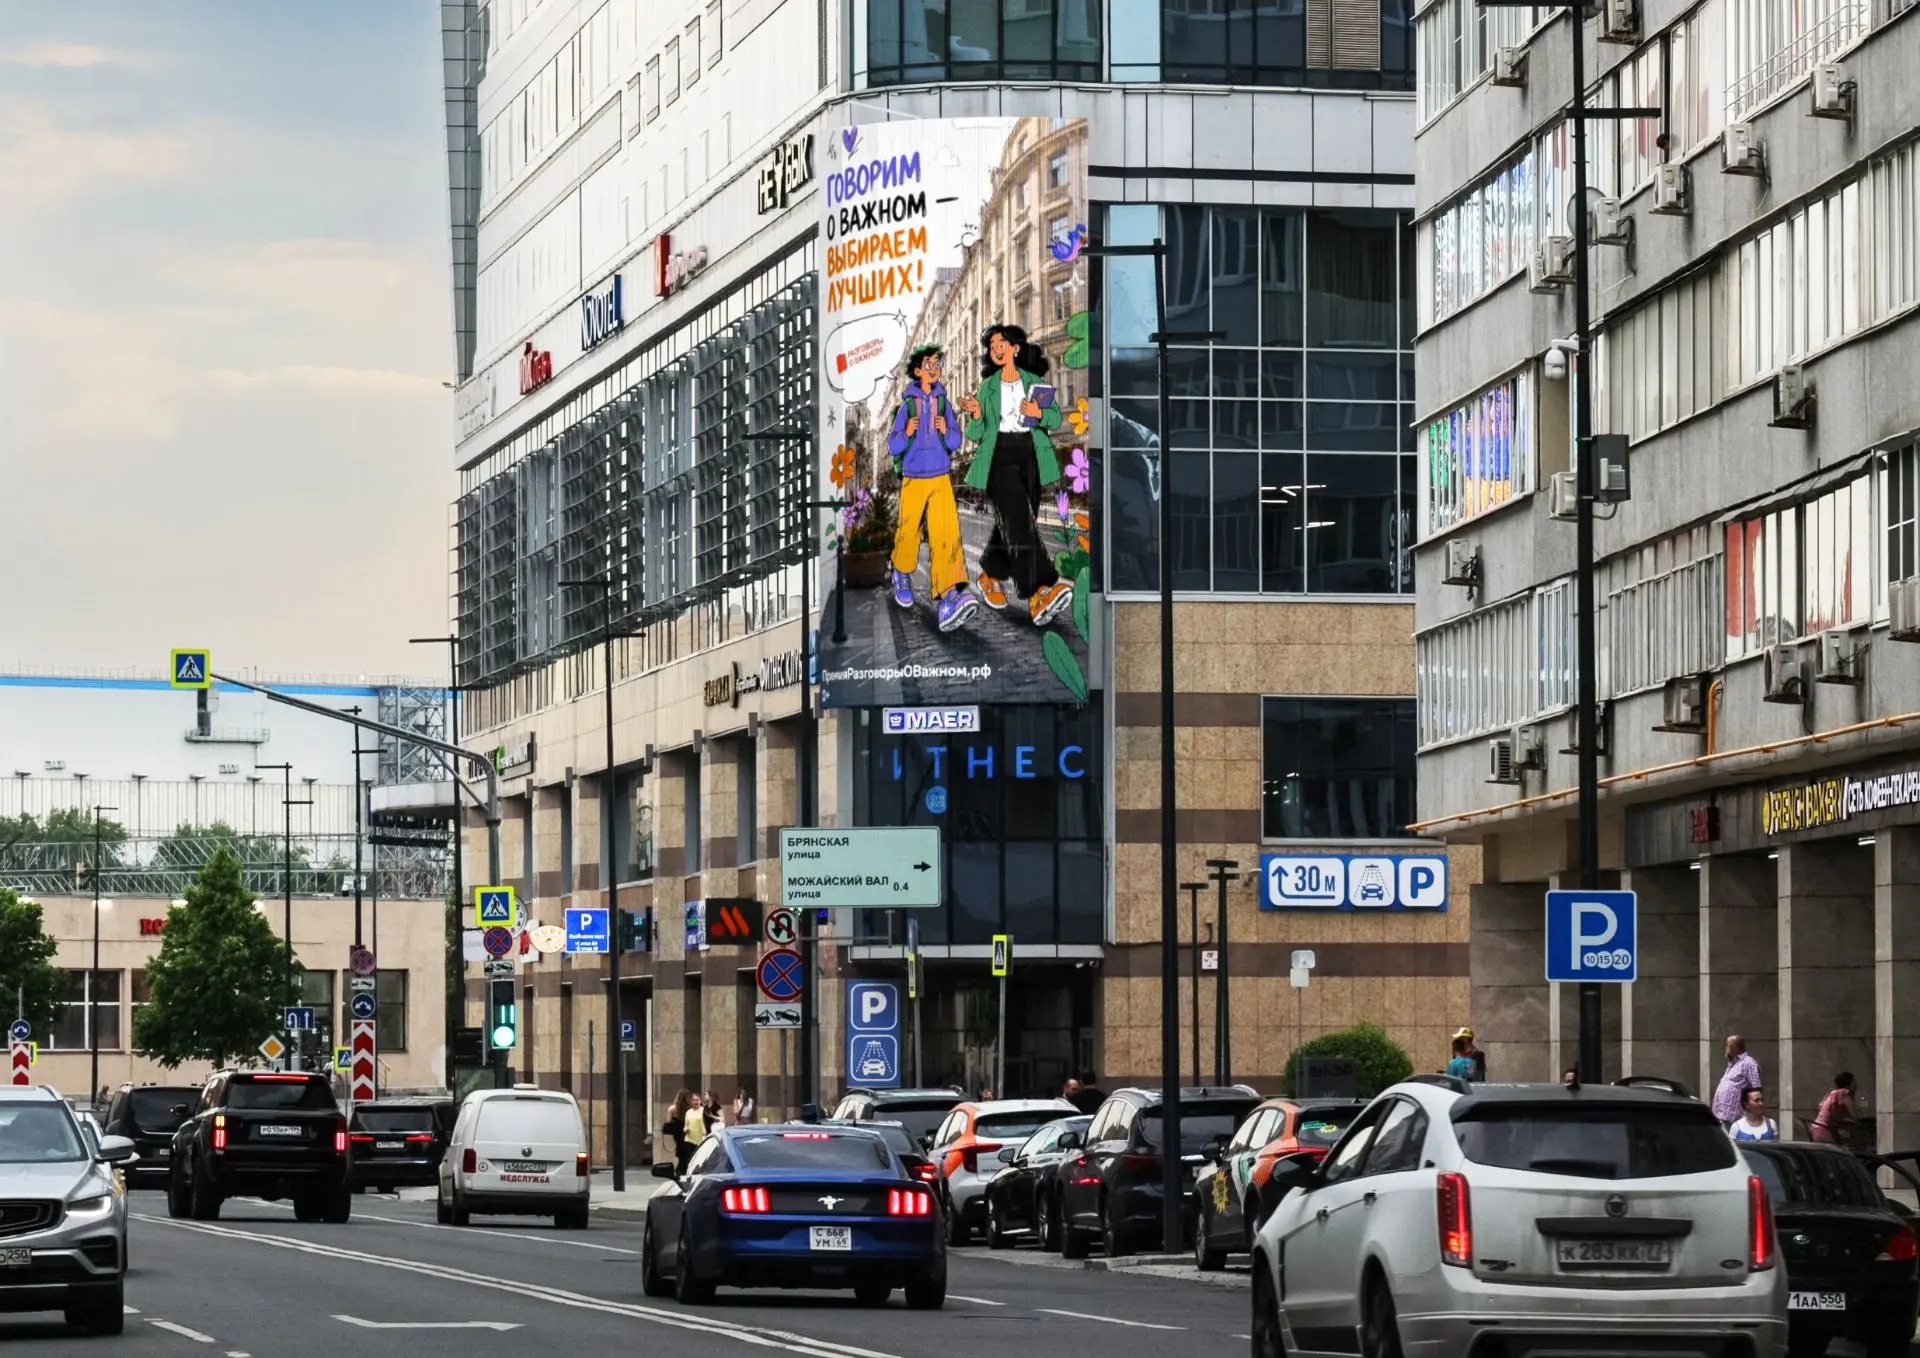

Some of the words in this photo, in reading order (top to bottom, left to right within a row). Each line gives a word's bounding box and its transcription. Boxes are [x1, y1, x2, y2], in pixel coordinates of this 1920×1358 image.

[827, 151, 921, 207] ГОВОРИМ
[827, 214, 836, 241] О
[840, 191, 927, 236] ВАЖНОМ
[827, 226, 928, 277] ВЫБИРАЕМ
[828, 259, 923, 314] ЛУЧШИХ!
[580, 279, 620, 350] NOVOTEL
[907, 711, 973, 729] MAER
[1772, 789, 1806, 832] FRENCH
[1806, 779, 1844, 826] BAKERY
[788, 838, 849, 846] БРЯНСКАЯ
[788, 876, 862, 886] МОЖАЙСКИЙ
[866, 876, 889, 885] ВАЛ
[893, 883, 909, 891] 0.4
[1295, 865, 1320, 892] 30
[1411, 867, 1434, 899] P
[788, 891, 821, 899] улица
[581, 913, 592, 931] P
[1571, 902, 1618, 970] P
[1586, 956, 1595, 964] 10
[1600, 956, 1609, 964] 15
[1614, 954, 1629, 965] 20
[862, 991, 887, 1023] P
[621, 1023, 632, 1037] P
[500, 1174, 550, 1183] МЕДСЛУЖБА
[1788, 1293, 1819, 1307] 1АА
[1820, 1293, 1842, 1304] 550
